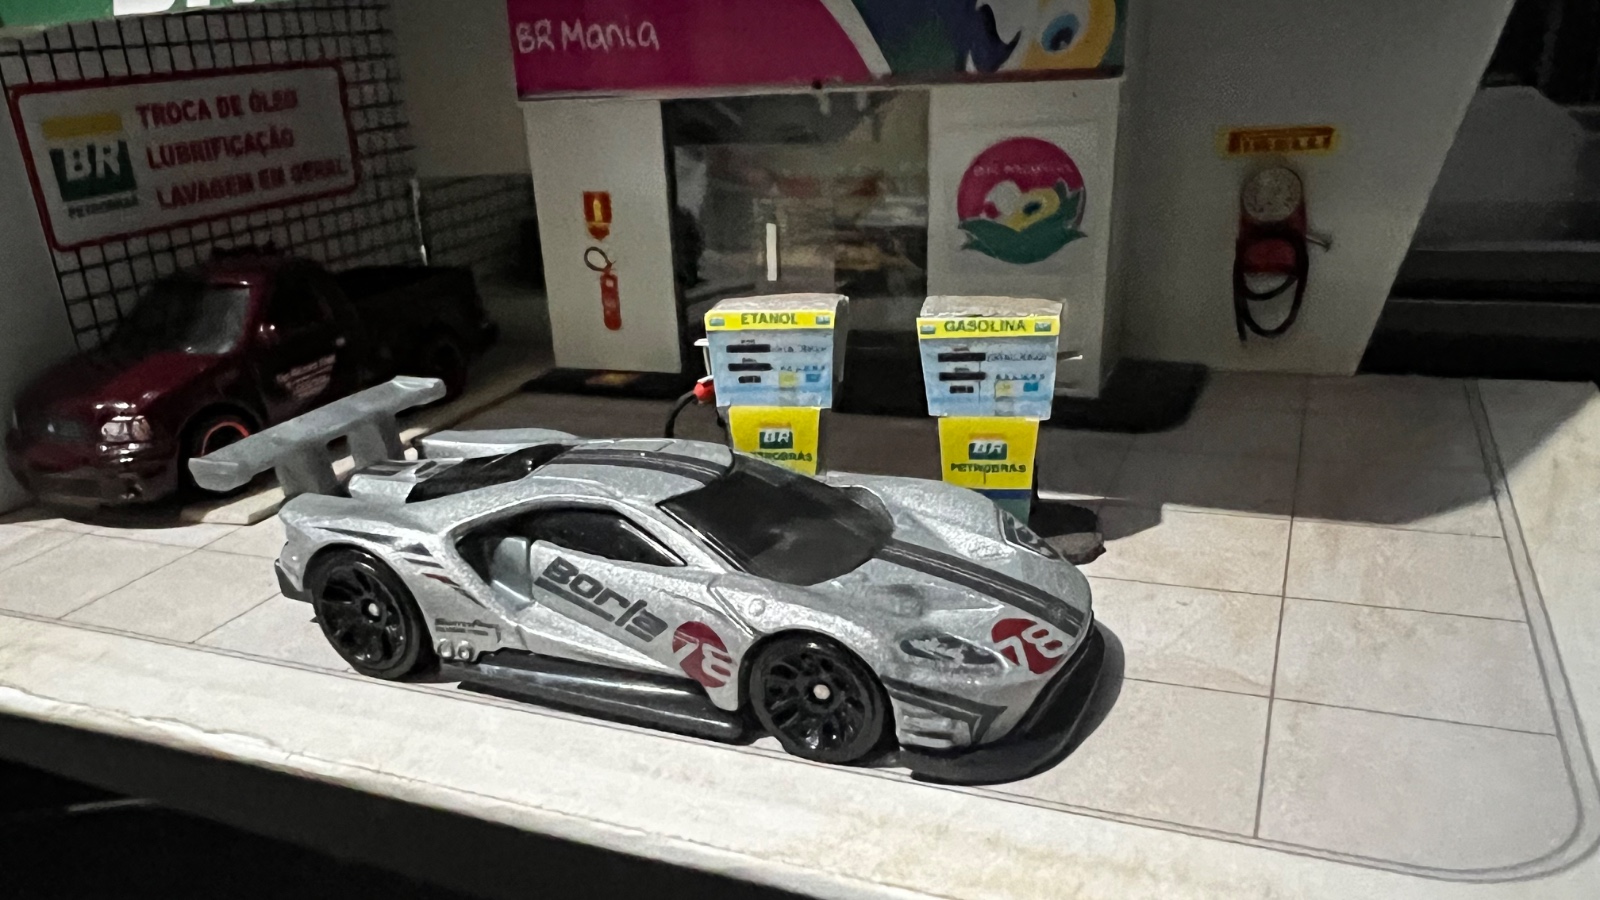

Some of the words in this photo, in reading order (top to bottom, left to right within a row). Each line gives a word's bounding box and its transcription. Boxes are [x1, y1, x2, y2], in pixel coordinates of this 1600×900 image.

[516, 19, 555, 54] BR
[560, 18, 660, 53] Mania
[136, 98, 212, 129] TROCA
[216, 95, 246, 119] DE
[62, 139, 122, 183] BR
[156, 173, 255, 210] LAVAGEM
[741, 312, 799, 326] ETANOL
[943, 319, 1027, 333] GASOLINA
[672, 625, 737, 688] 78
[992, 620, 1069, 673] 78
